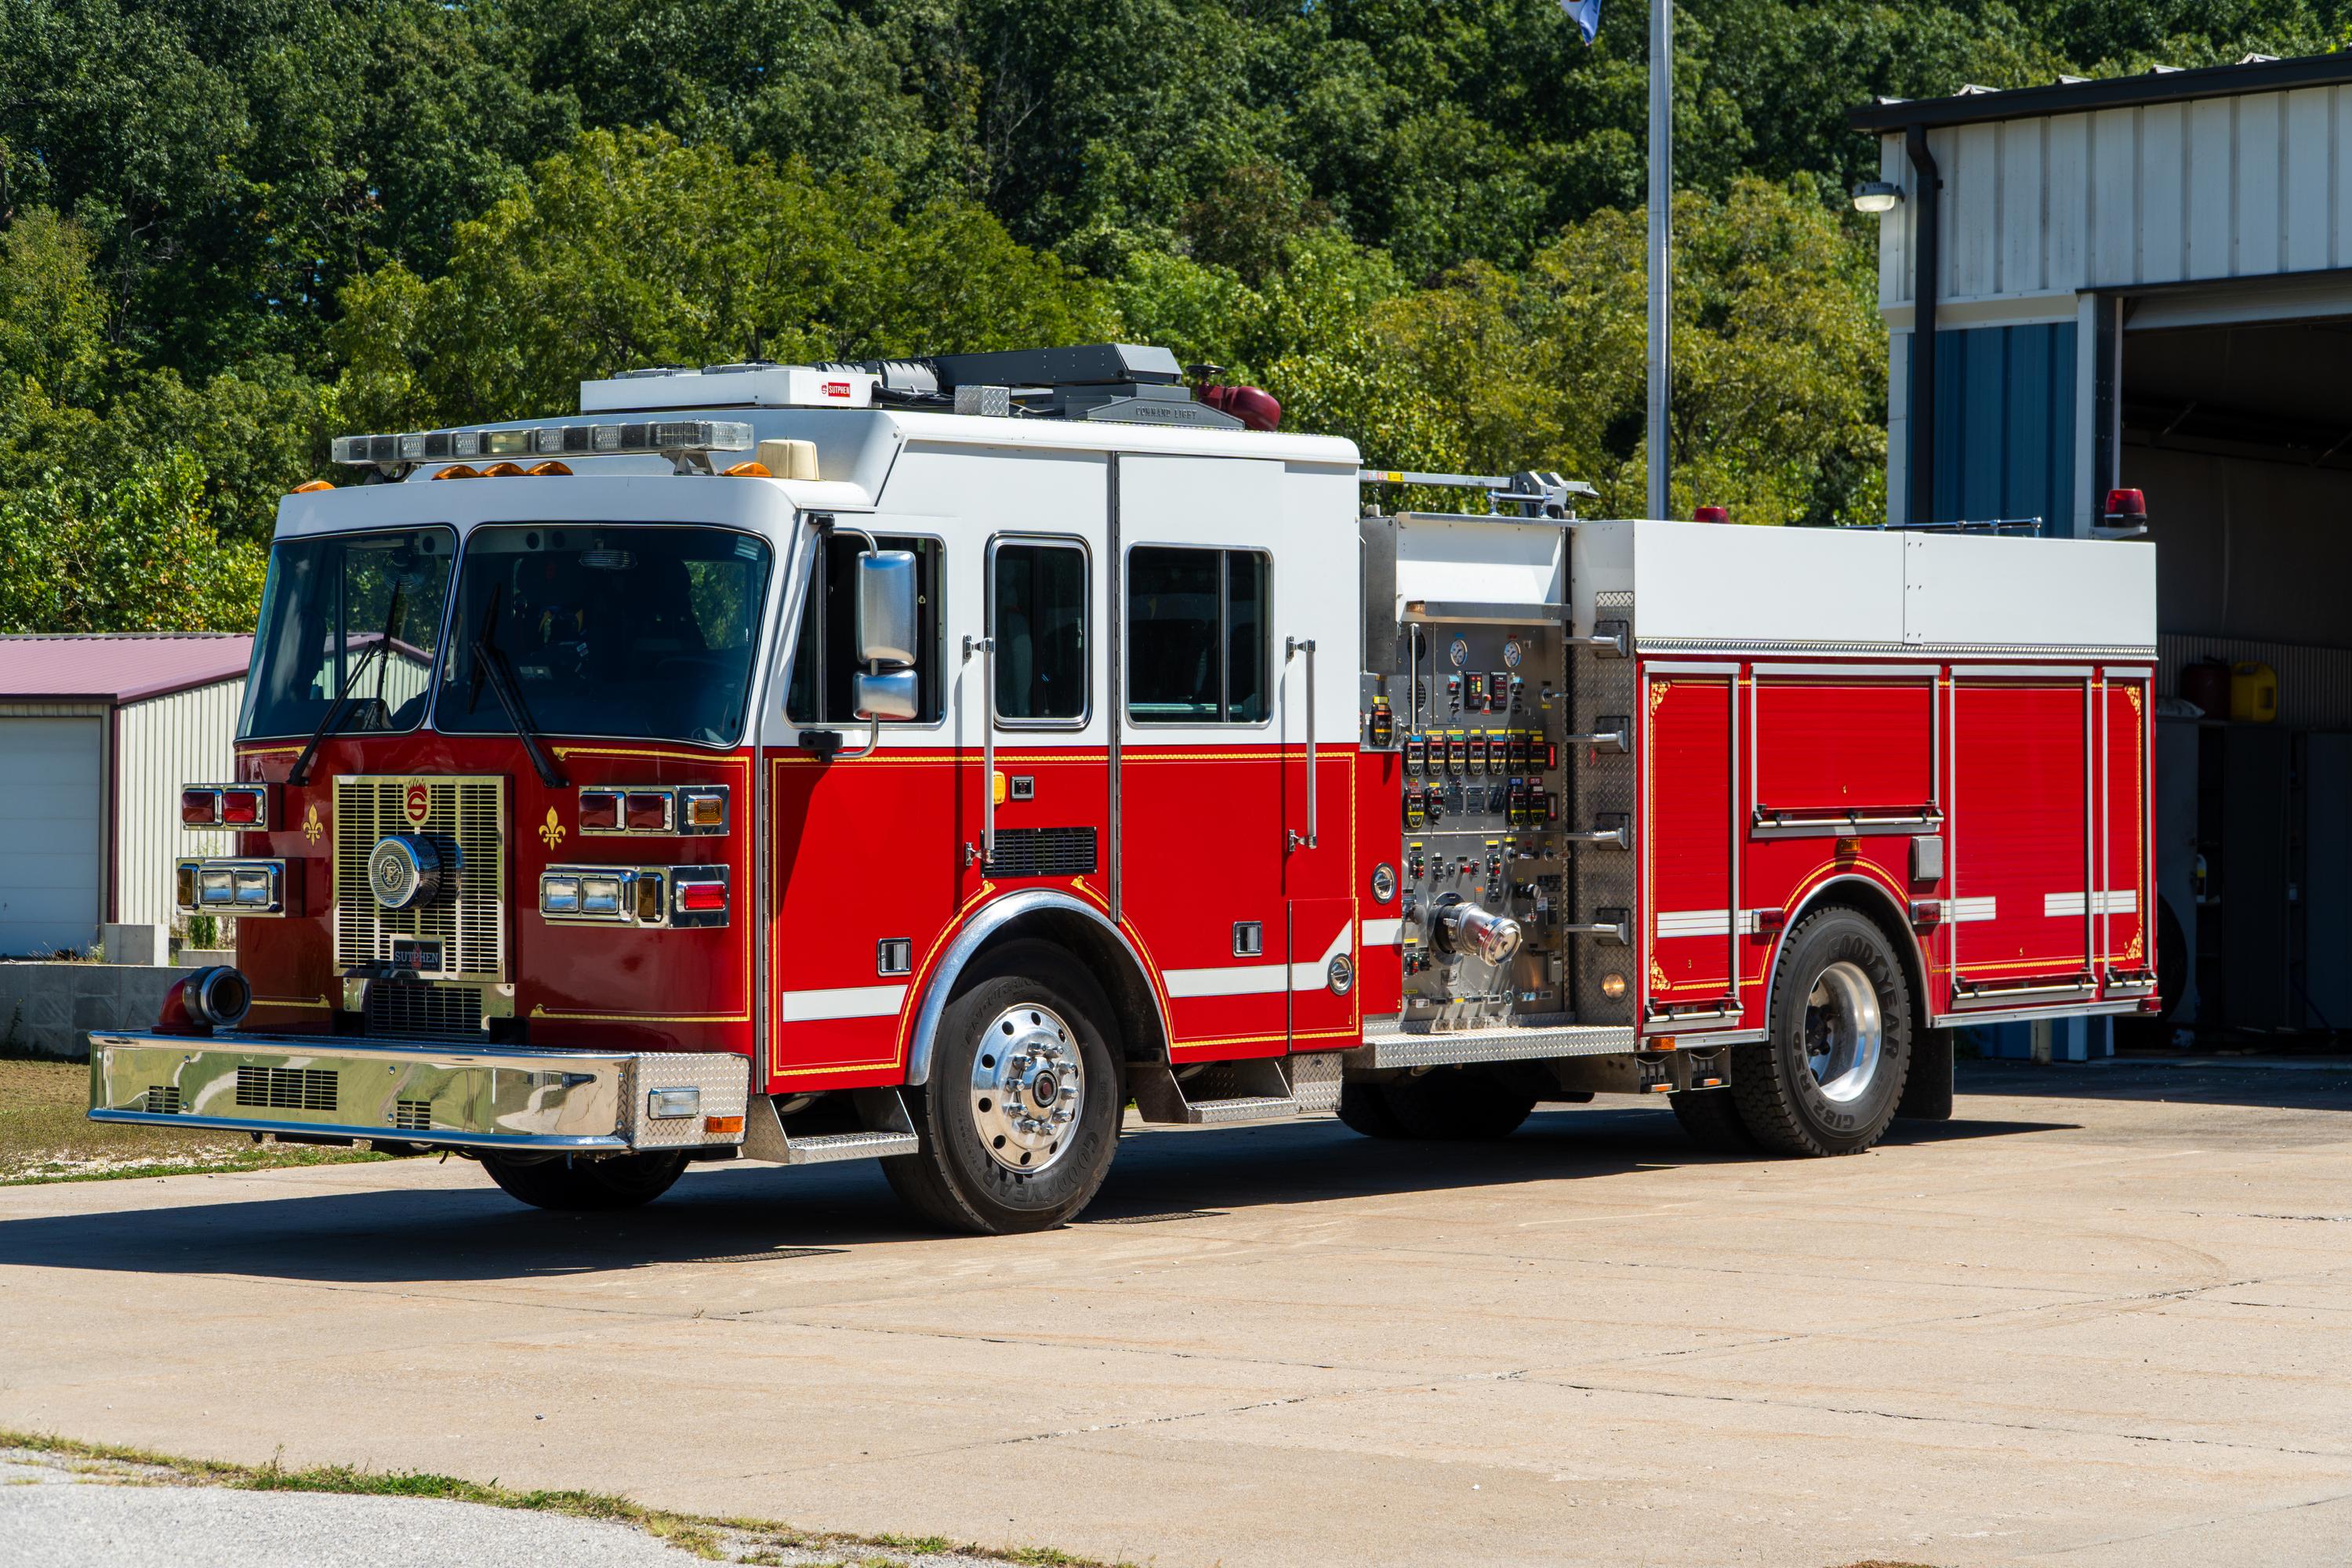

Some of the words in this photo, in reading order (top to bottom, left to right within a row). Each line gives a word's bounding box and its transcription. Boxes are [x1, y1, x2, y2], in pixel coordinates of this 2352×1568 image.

[829, 385, 850, 394] SUTPHEN
[1135, 406, 1171, 419] COMMAND
[1174, 408, 1197, 419] LIGHT
[394, 950, 439, 964] SUTPHEN
[1828, 935, 1900, 1059] GOODYEAR
[1396, 999, 1402, 1009] 2
[982, 1131, 1100, 1203] GOODYEAR
